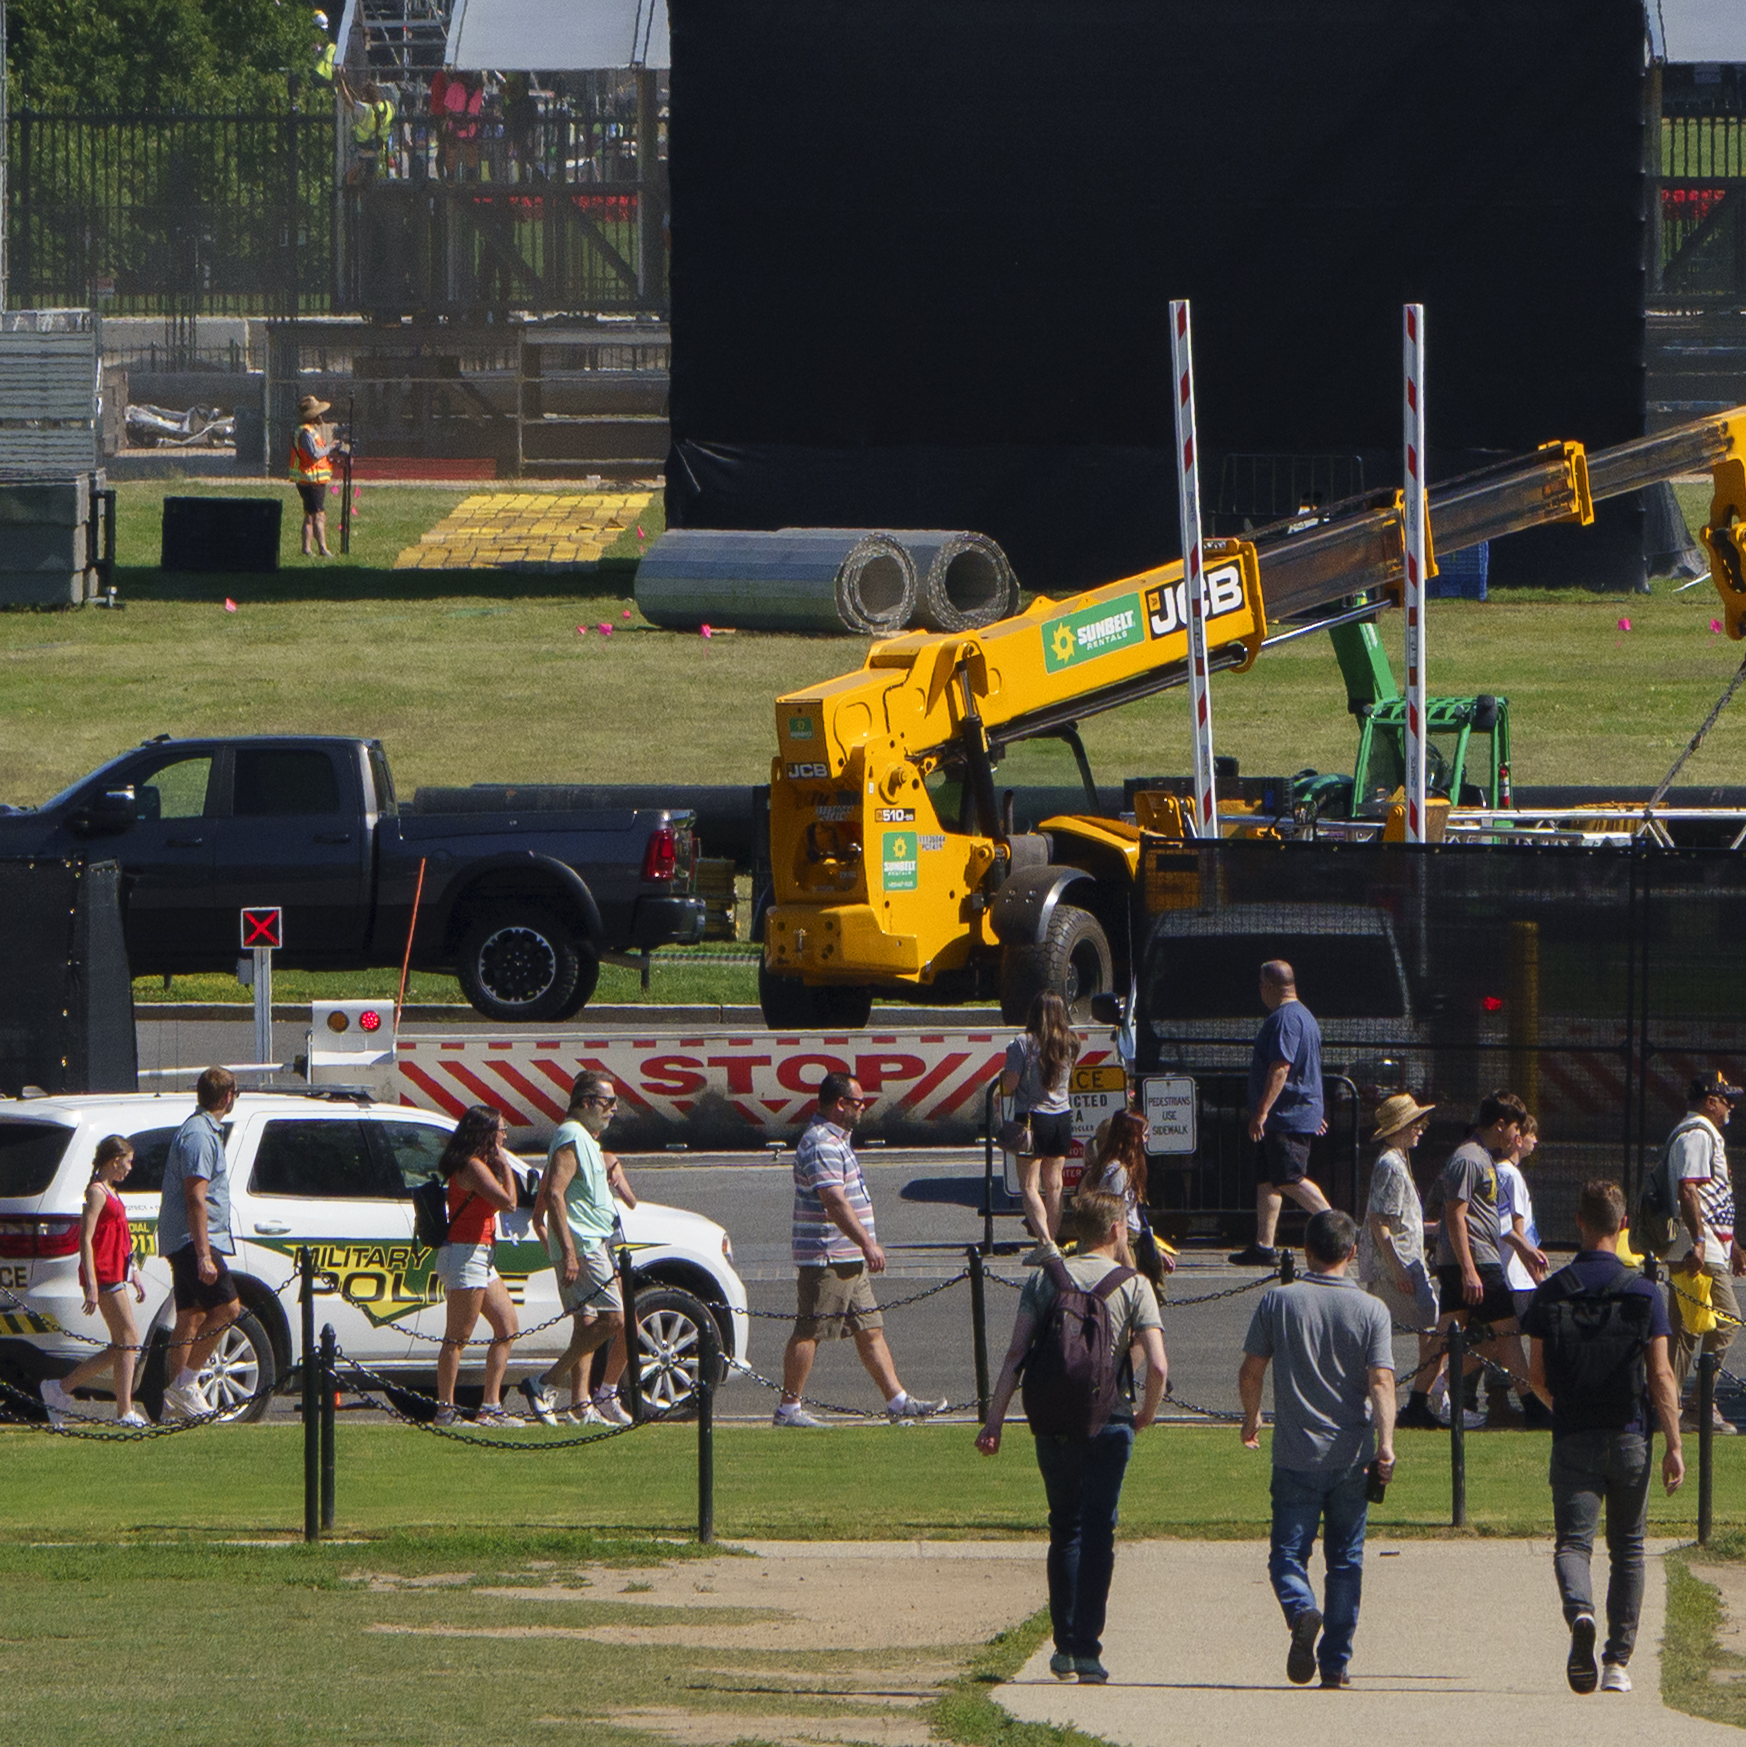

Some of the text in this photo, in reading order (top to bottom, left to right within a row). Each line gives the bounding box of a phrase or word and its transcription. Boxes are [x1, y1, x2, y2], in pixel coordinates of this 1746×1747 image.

[1151, 565, 1243, 635] JCB
[1077, 609, 1134, 646] SUNBELT
[1086, 630, 1128, 650] RENTALS
[788, 763, 828, 778] JCB
[639, 1054, 927, 1096] STOP
[1148, 1096, 1191, 1106] PEDESTRIANS
[1162, 1111, 1177, 1121] USE
[1153, 1126, 1189, 1136] SIDEWALK
[293, 1245, 433, 1270] MILITARY
[296, 1272, 529, 1305] POLI
